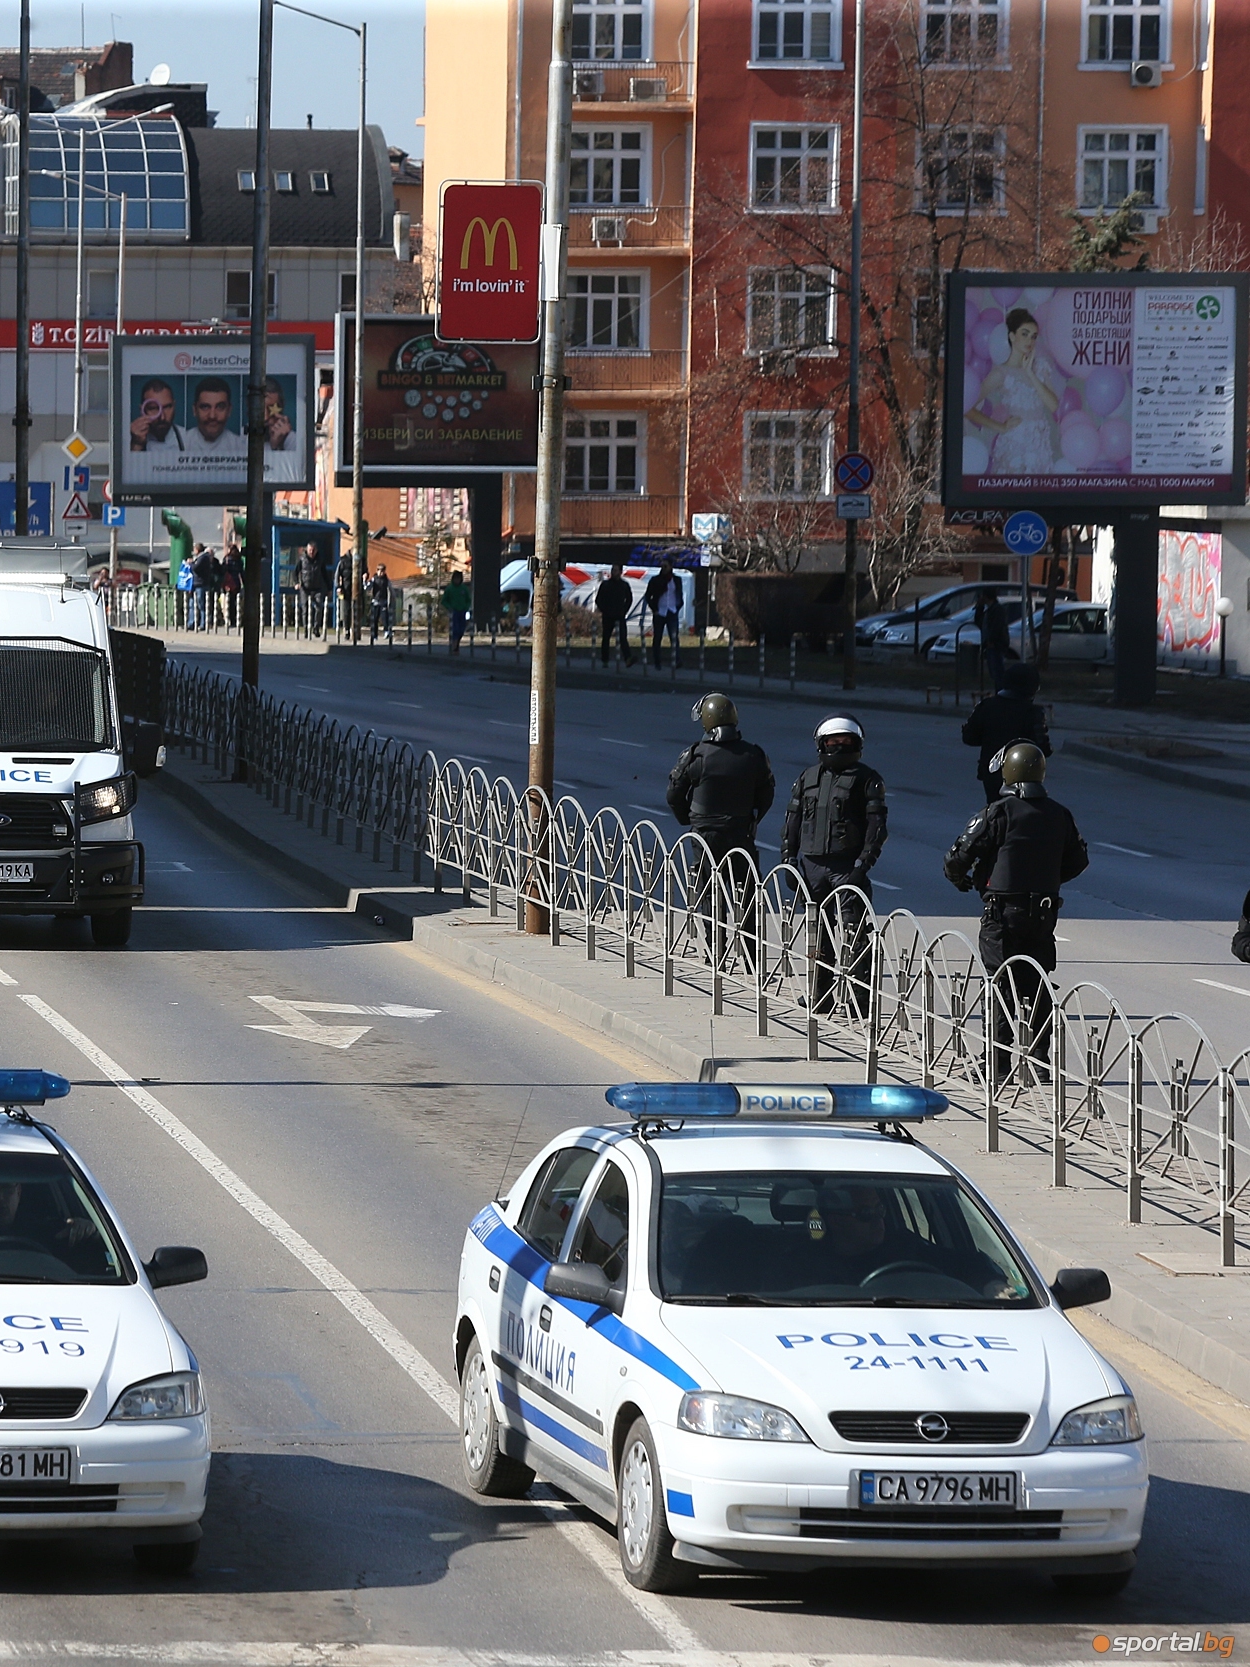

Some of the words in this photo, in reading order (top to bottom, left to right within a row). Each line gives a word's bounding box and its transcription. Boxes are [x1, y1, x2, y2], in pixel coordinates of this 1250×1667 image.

[453, 278, 474, 292] i'm
[476, 278, 513, 293] lovin'
[1073, 291, 1132, 310] СТИЛНИ
[1148, 302, 1194, 311] PARADISE
[1072, 310, 1132, 326] ПОДАРЪЦИ
[1072, 328, 1083, 339] ЗА
[1085, 328, 1131, 339] БЛЕСТЯЩИ
[193, 354, 251, 366] MasterChe
[1071, 340, 1131, 366] ЖЕНИ
[381, 374, 422, 386] BINGO
[363, 427, 411, 441] ИЗБЕРИ
[414, 428, 435, 441] СИ
[438, 428, 524, 441] ЗАБАВЛЕНИЕ
[178, 455, 191, 464] ОТ
[978, 476, 1031, 488] ПАЗАРУВАЙ
[1040, 478, 1060, 488] НАД
[1061, 478, 1077, 487] 350
[1079, 478, 1128, 488] МАГАЗИНА
[1138, 478, 1157, 488] НАД
[1160, 478, 1181, 488] 1000
[1182, 478, 1215, 488] МАРКИ
[107, 507, 121, 524] P
[746, 1095, 826, 1112] POLICE
[776, 1332, 1018, 1352] POLICE
[507, 1310, 576, 1395] ПОЛИЦИЯ
[844, 1355, 989, 1372] 24-1111
[915, 1476, 974, 1501] 9796
